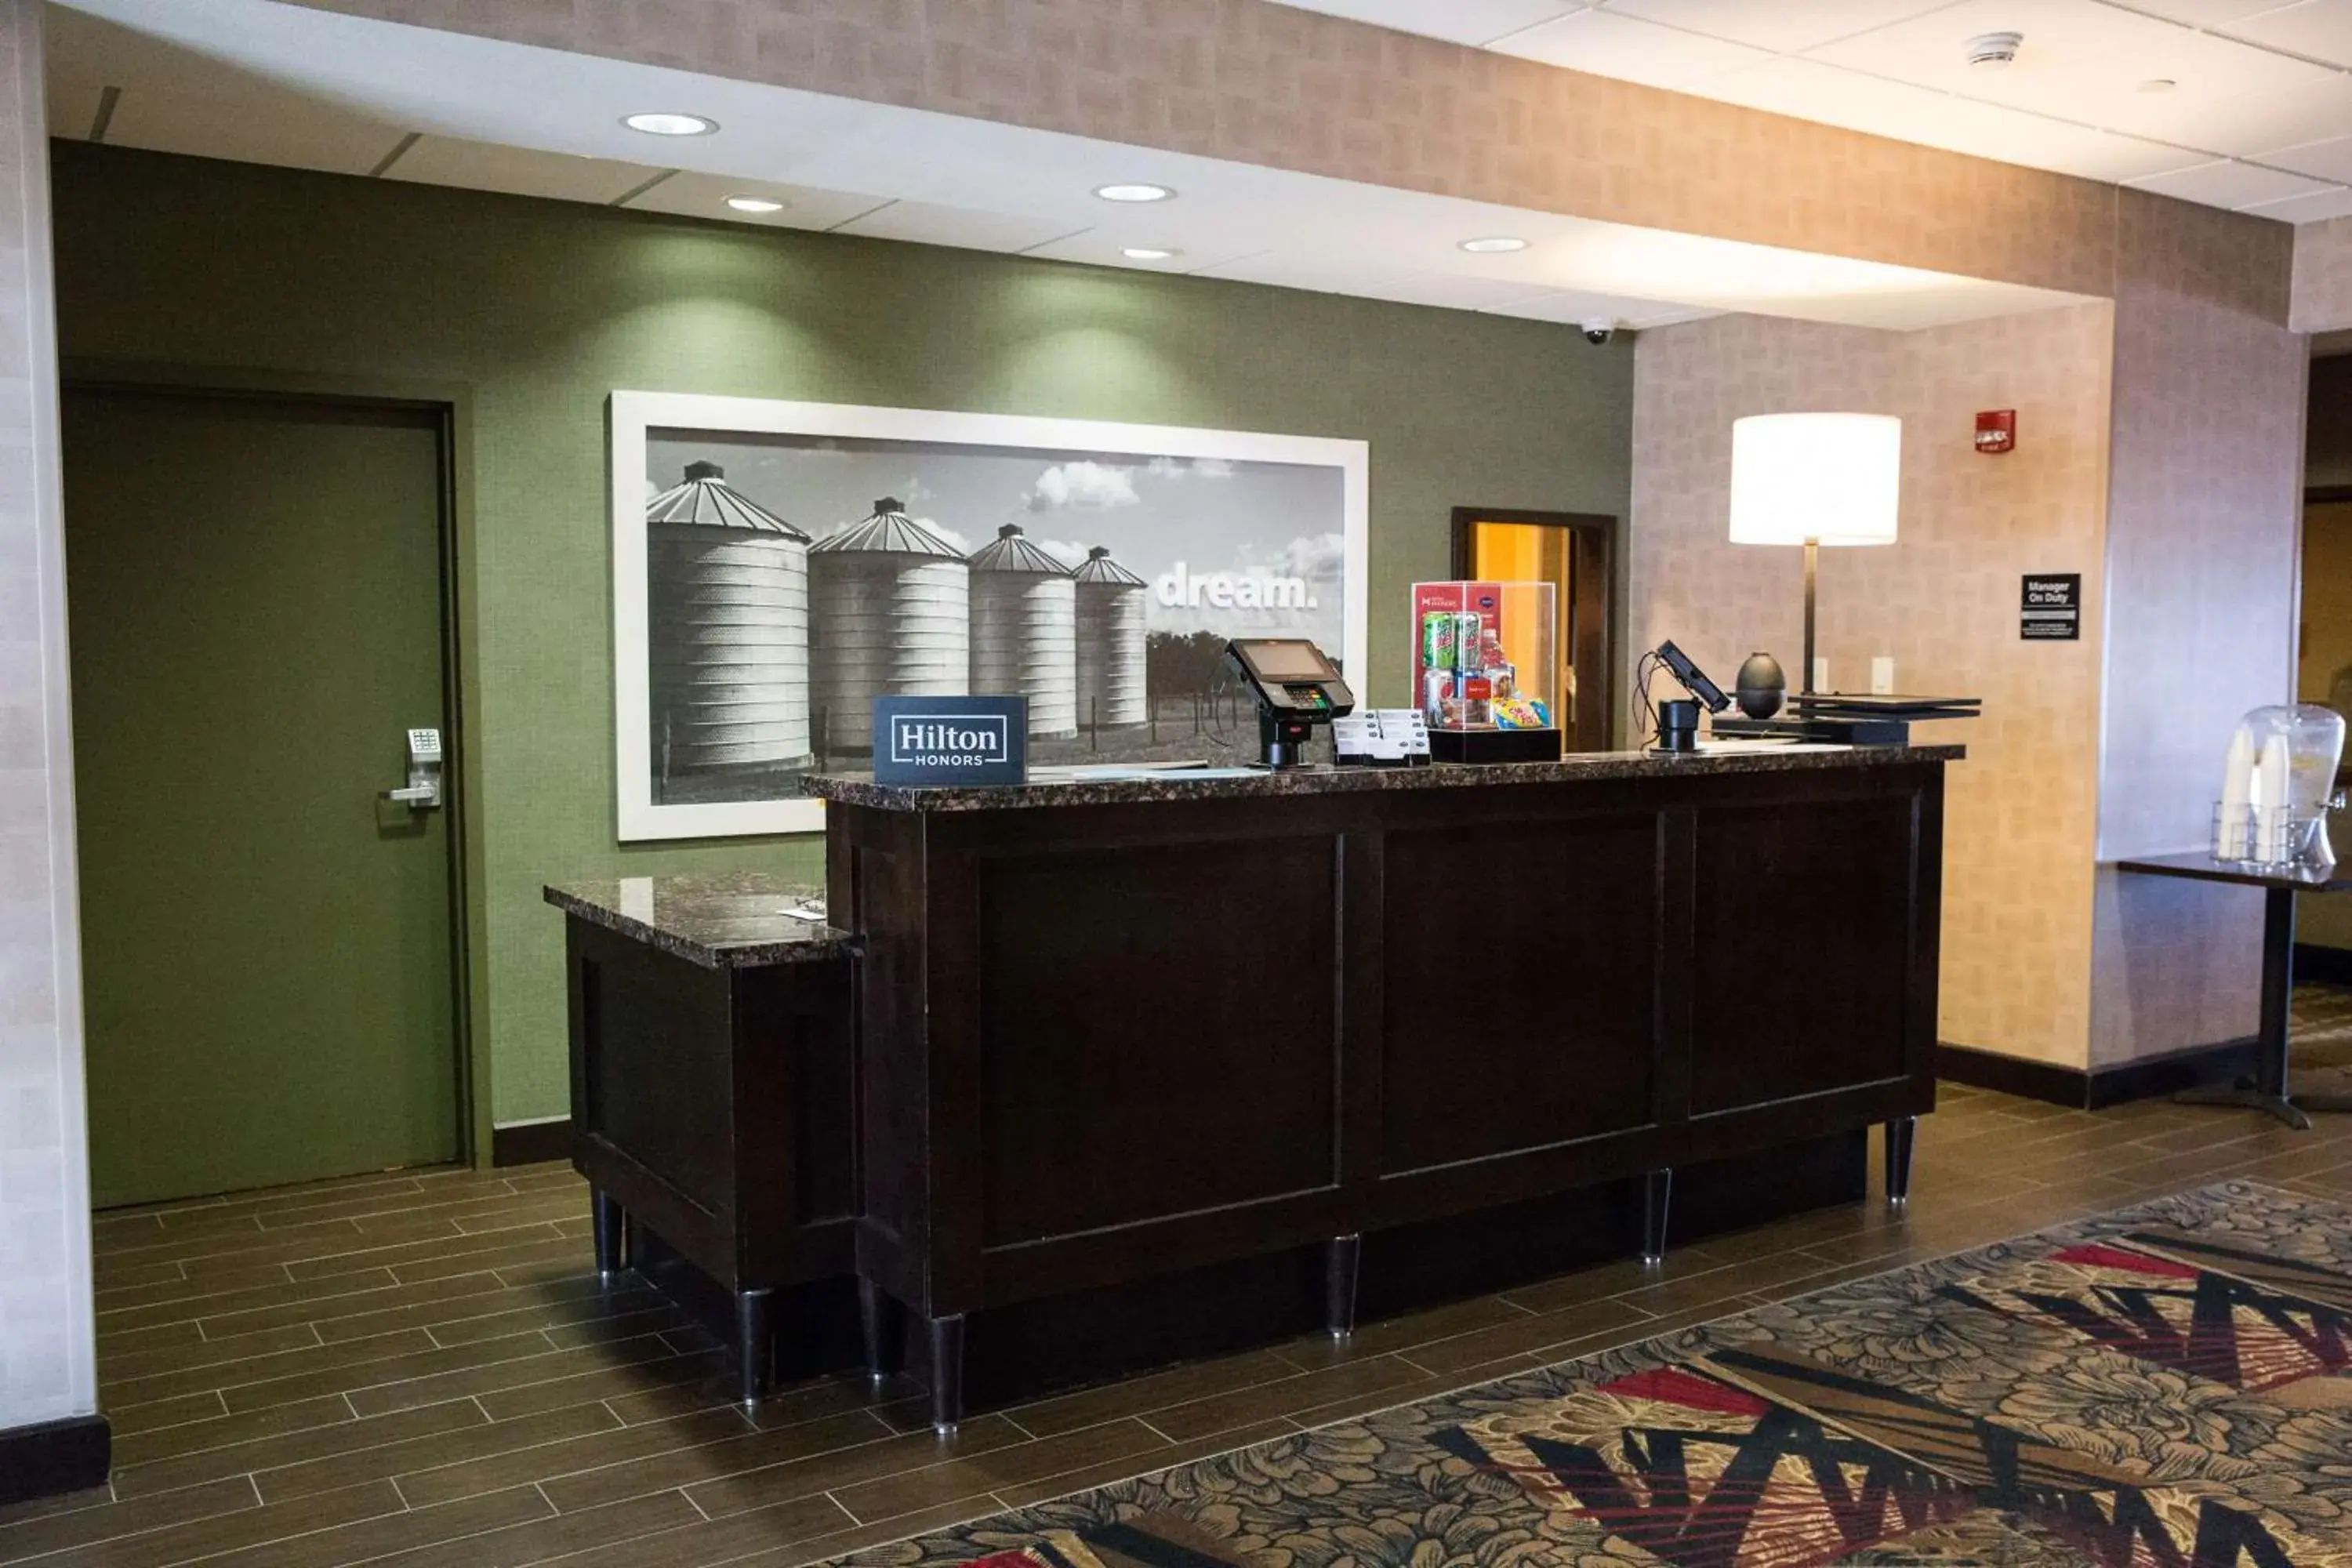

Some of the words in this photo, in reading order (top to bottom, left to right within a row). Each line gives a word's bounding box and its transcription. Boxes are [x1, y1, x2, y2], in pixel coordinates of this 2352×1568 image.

[1156, 561, 1318, 608] dream.
[2028, 582, 2070, 593] Manager
[2028, 593, 2043, 602] On
[2045, 593, 2069, 604] Duty
[901, 724, 997, 750] Hilton
[915, 754, 983, 766] HONORS
